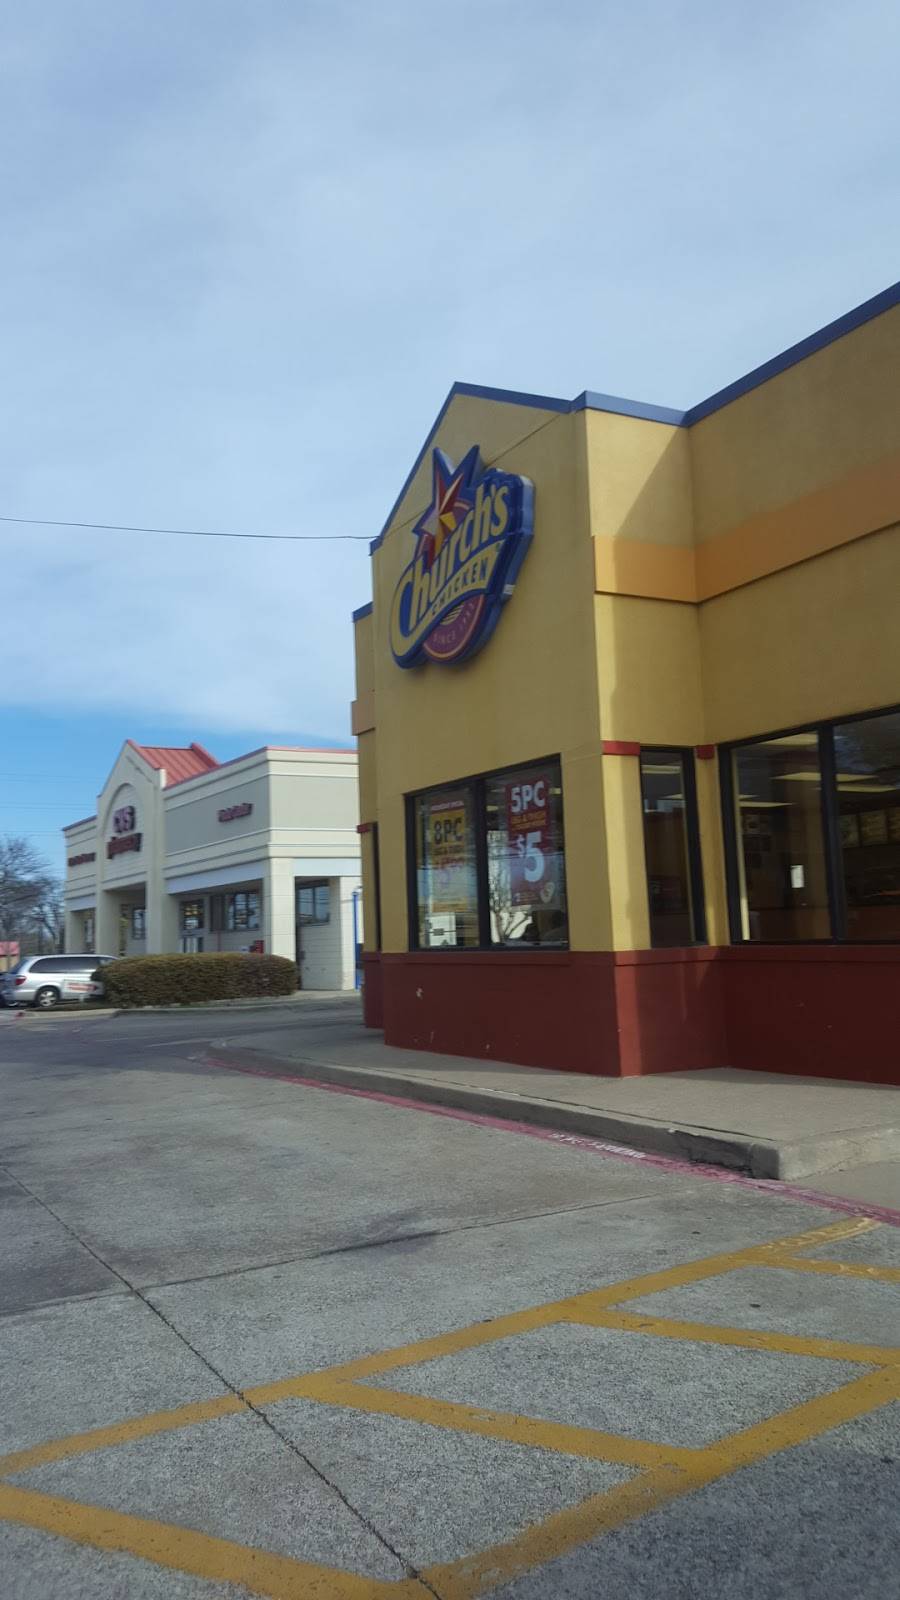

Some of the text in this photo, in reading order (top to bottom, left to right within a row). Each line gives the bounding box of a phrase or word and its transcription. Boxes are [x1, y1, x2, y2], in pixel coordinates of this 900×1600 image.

[390, 484, 509, 657] Church's
[431, 556, 489, 617] CHICKEN
[511, 781, 546, 813] 5PC
[433, 817, 464, 845] 8PC
[517, 832, 546, 883] $5
